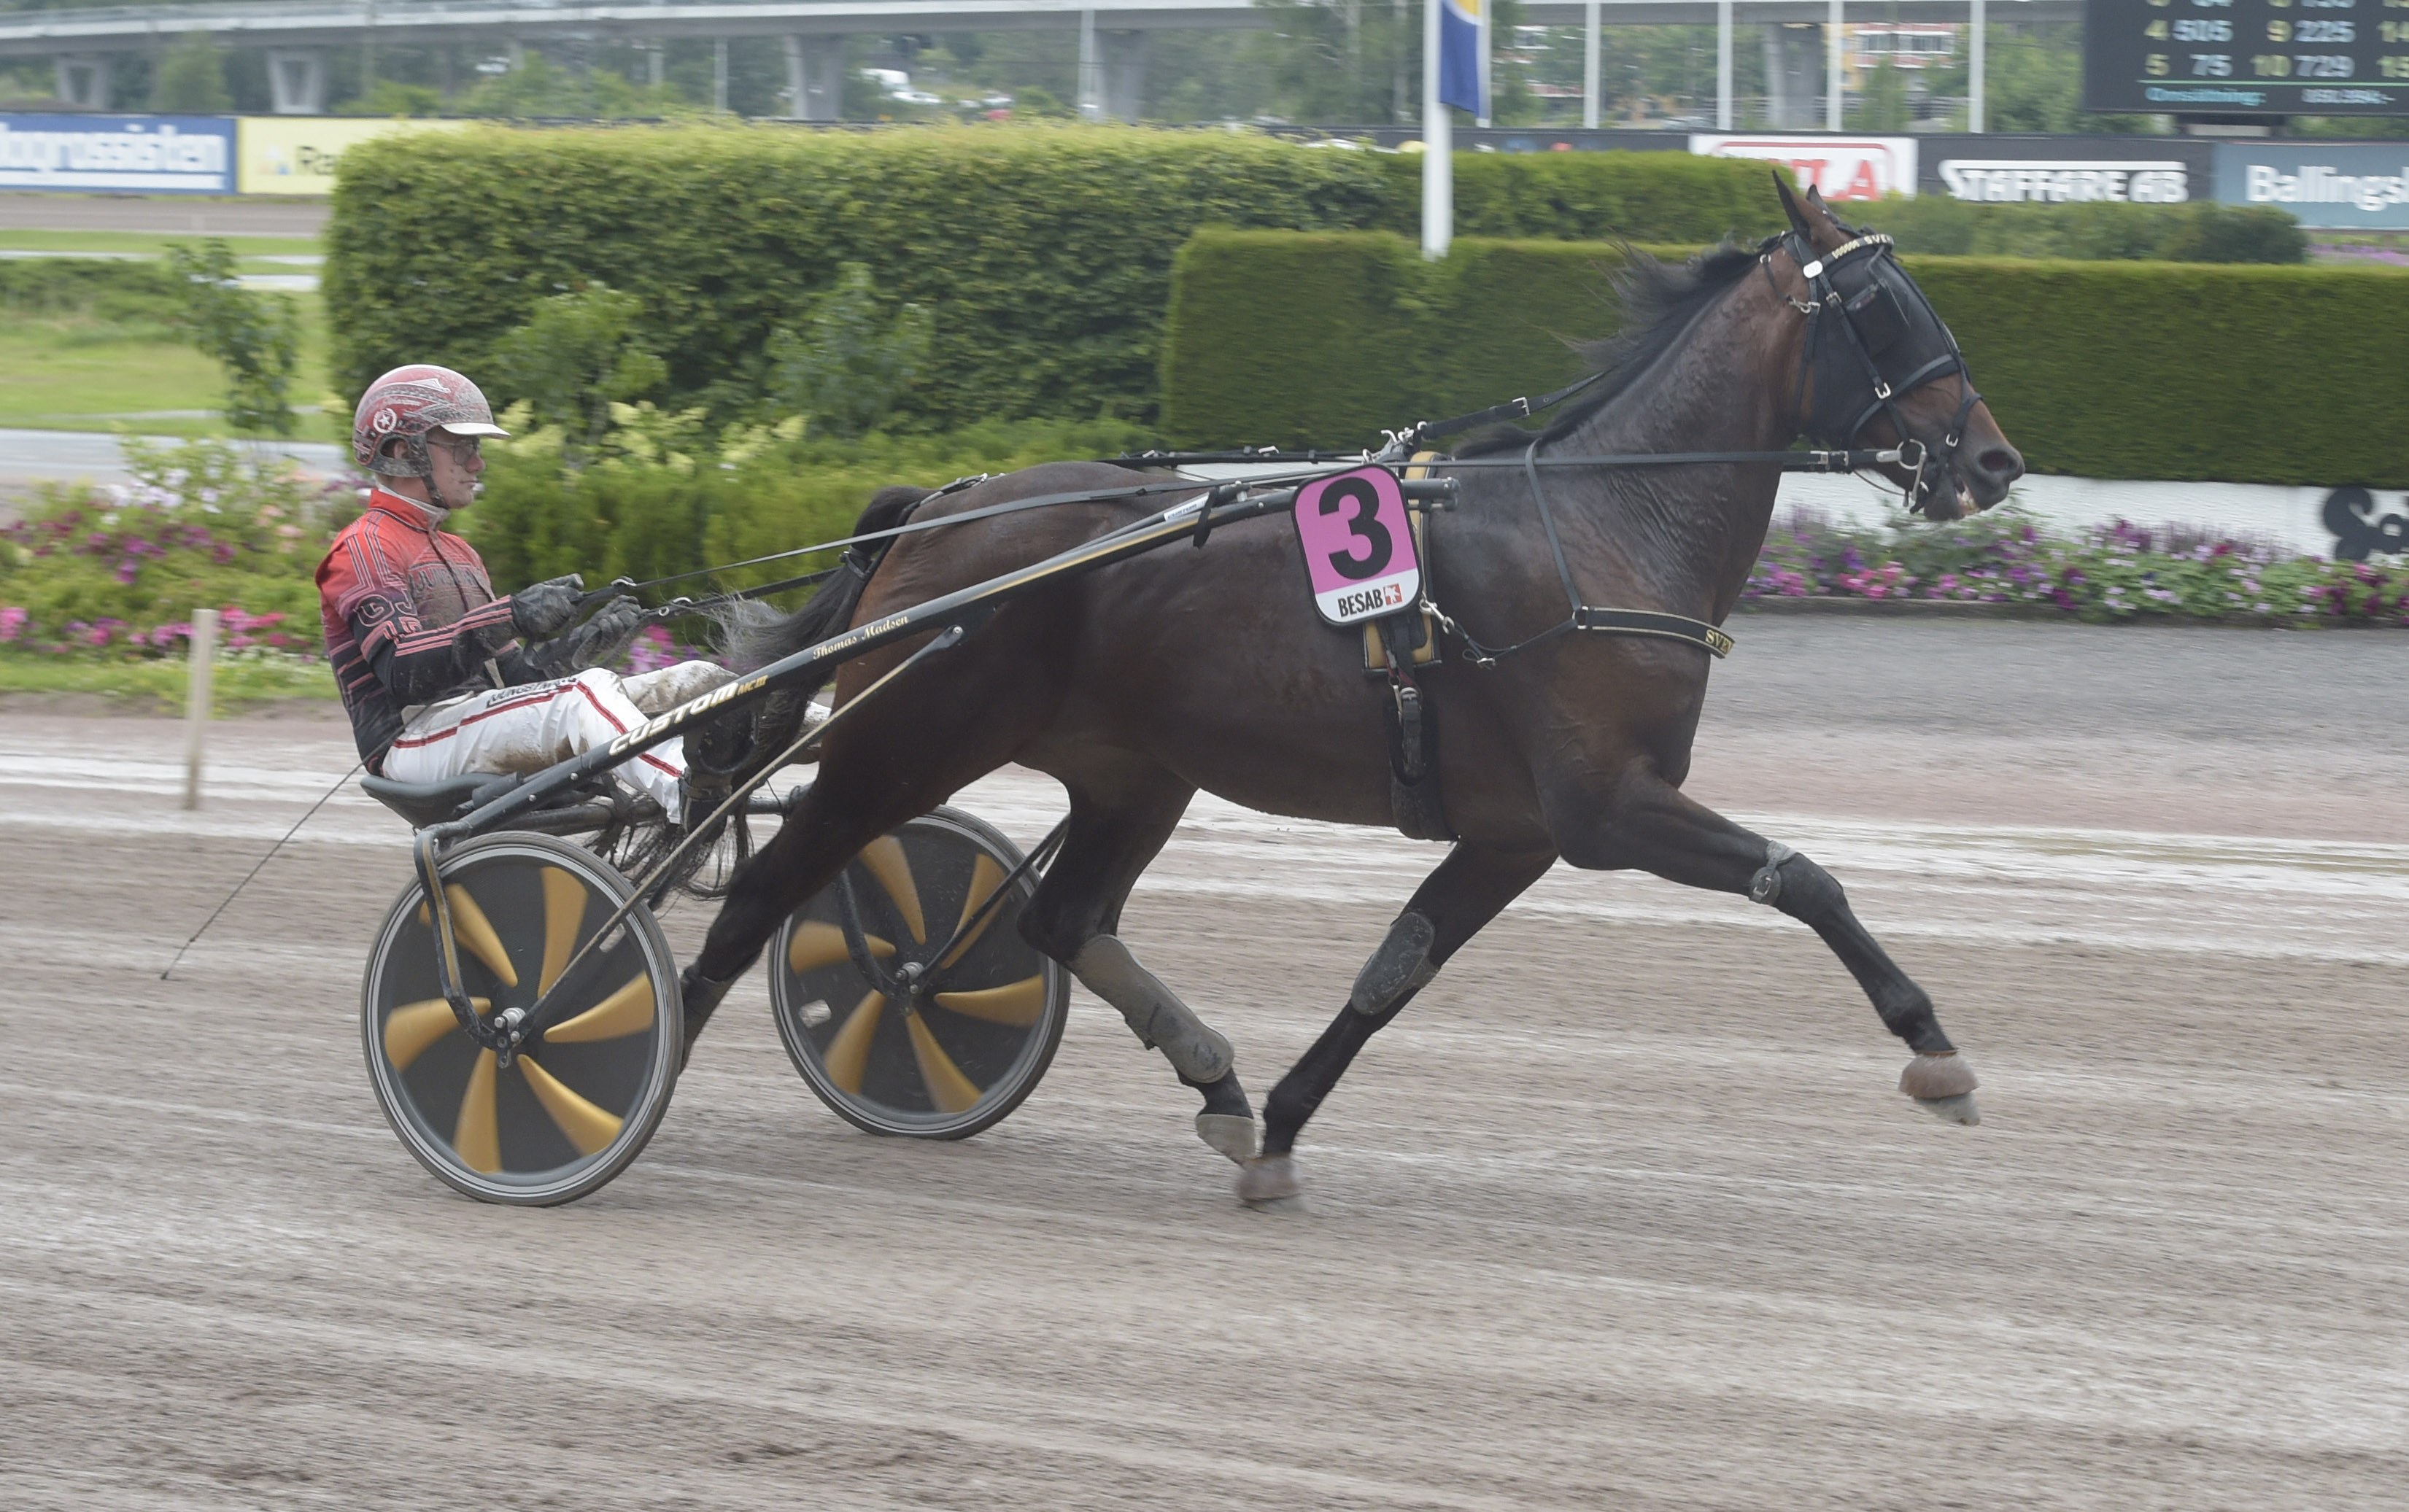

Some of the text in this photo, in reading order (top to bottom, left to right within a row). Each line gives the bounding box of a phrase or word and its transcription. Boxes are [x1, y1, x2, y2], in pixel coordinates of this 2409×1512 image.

[2143, 20, 2170, 41] 4
[2145, 53, 2233, 76] 5 75
[1318, 477, 1393, 581] 3
[1337, 589, 1384, 618] BESAB
[813, 616, 910, 660] Thomas Madsen
[608, 682, 739, 756] CUSTOM
